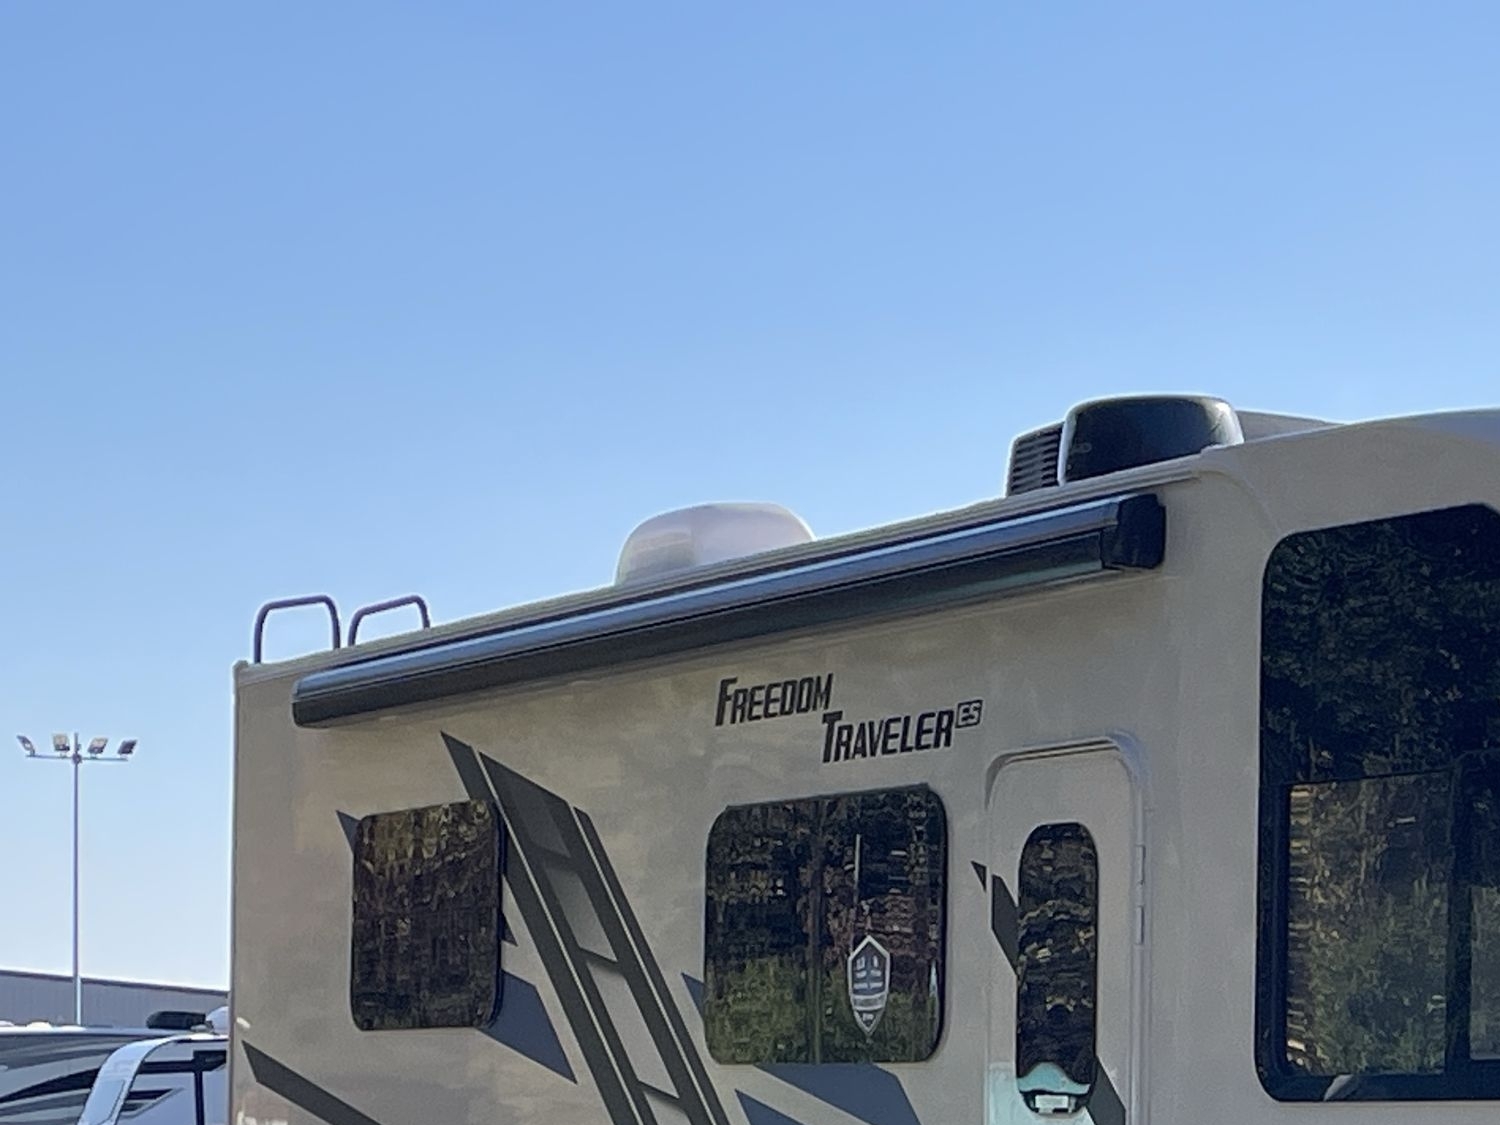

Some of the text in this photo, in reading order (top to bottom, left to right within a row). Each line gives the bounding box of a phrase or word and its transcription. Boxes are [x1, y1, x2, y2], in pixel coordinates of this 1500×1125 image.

[715, 673, 834, 726] FREEDOM
[822, 701, 982, 763] TRAVELER ES
